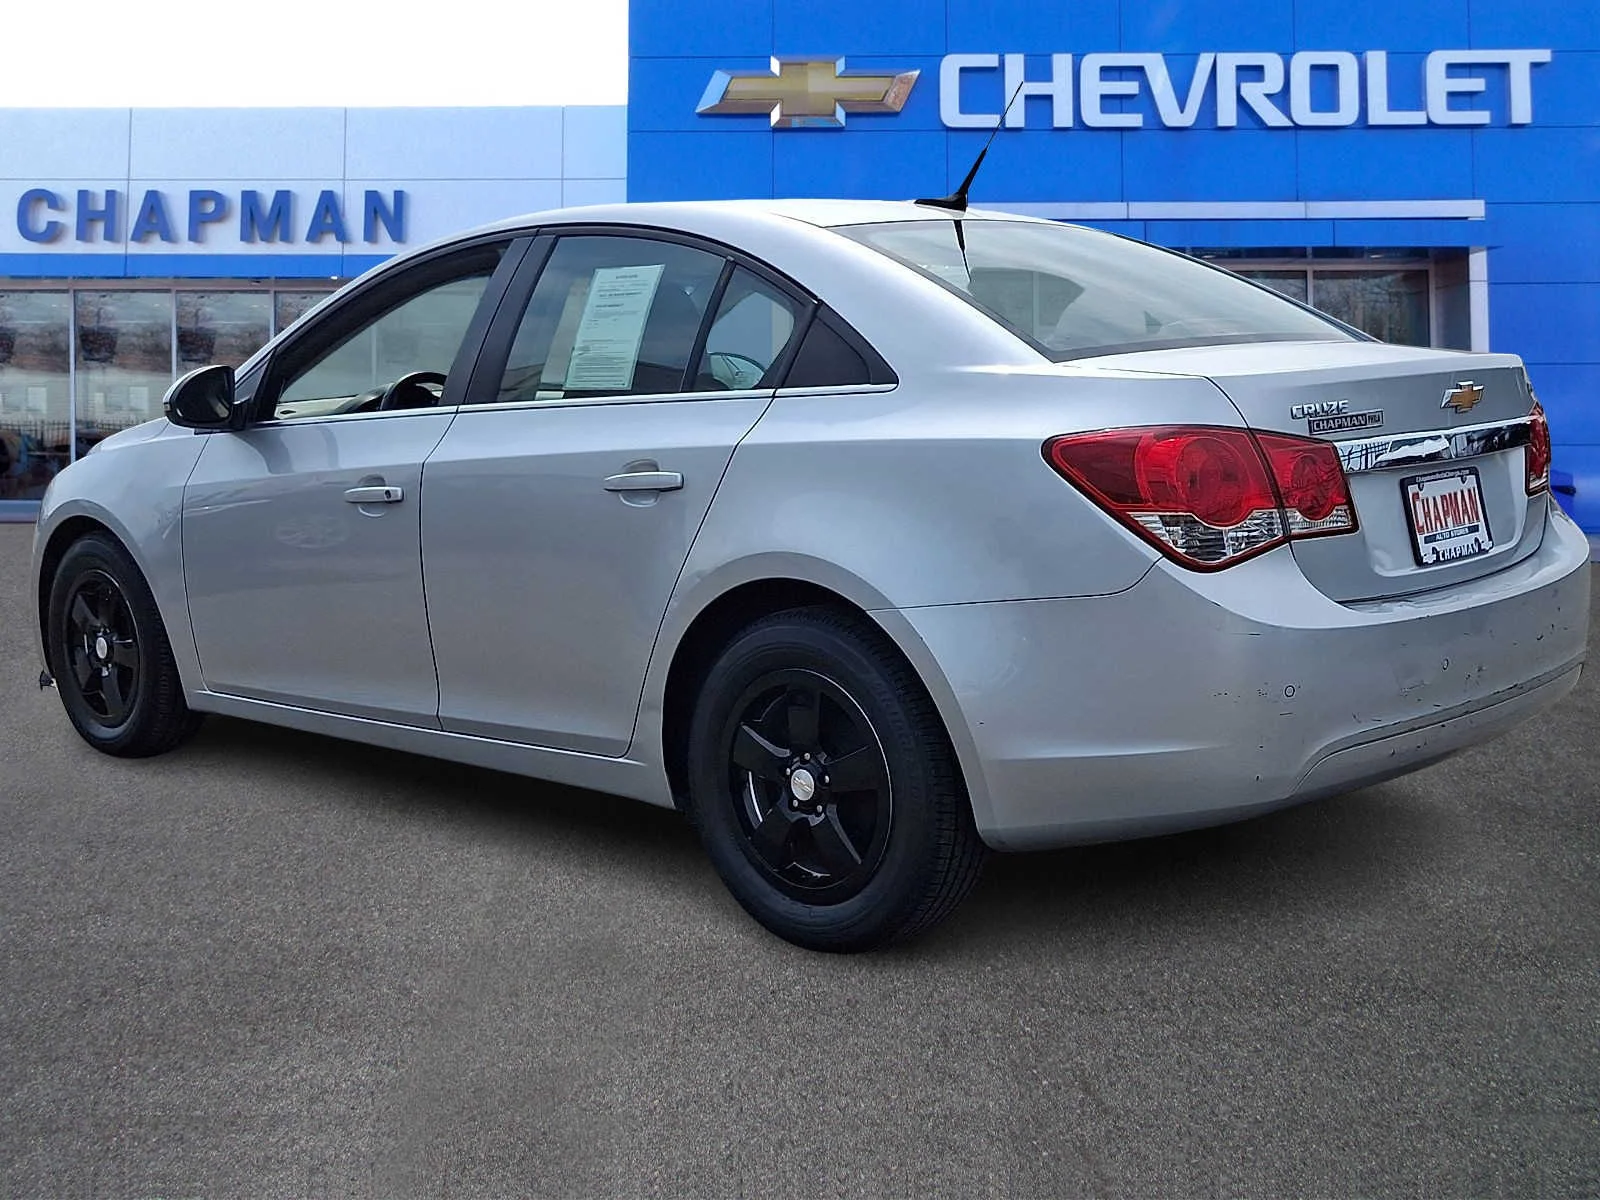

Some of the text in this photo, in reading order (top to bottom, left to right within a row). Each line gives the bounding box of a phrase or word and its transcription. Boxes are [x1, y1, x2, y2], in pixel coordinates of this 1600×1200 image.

[938, 48, 1552, 129] CHEVROLET
[16, 187, 408, 243] CHAPMAN
[1291, 400, 1349, 419] CRUZE
[1313, 414, 1366, 431] CHAPMAN
[1411, 487, 1480, 535] CHAPMAN
[1435, 530, 1450, 541] AUTO
[1439, 541, 1479, 561] CHAPMAN
